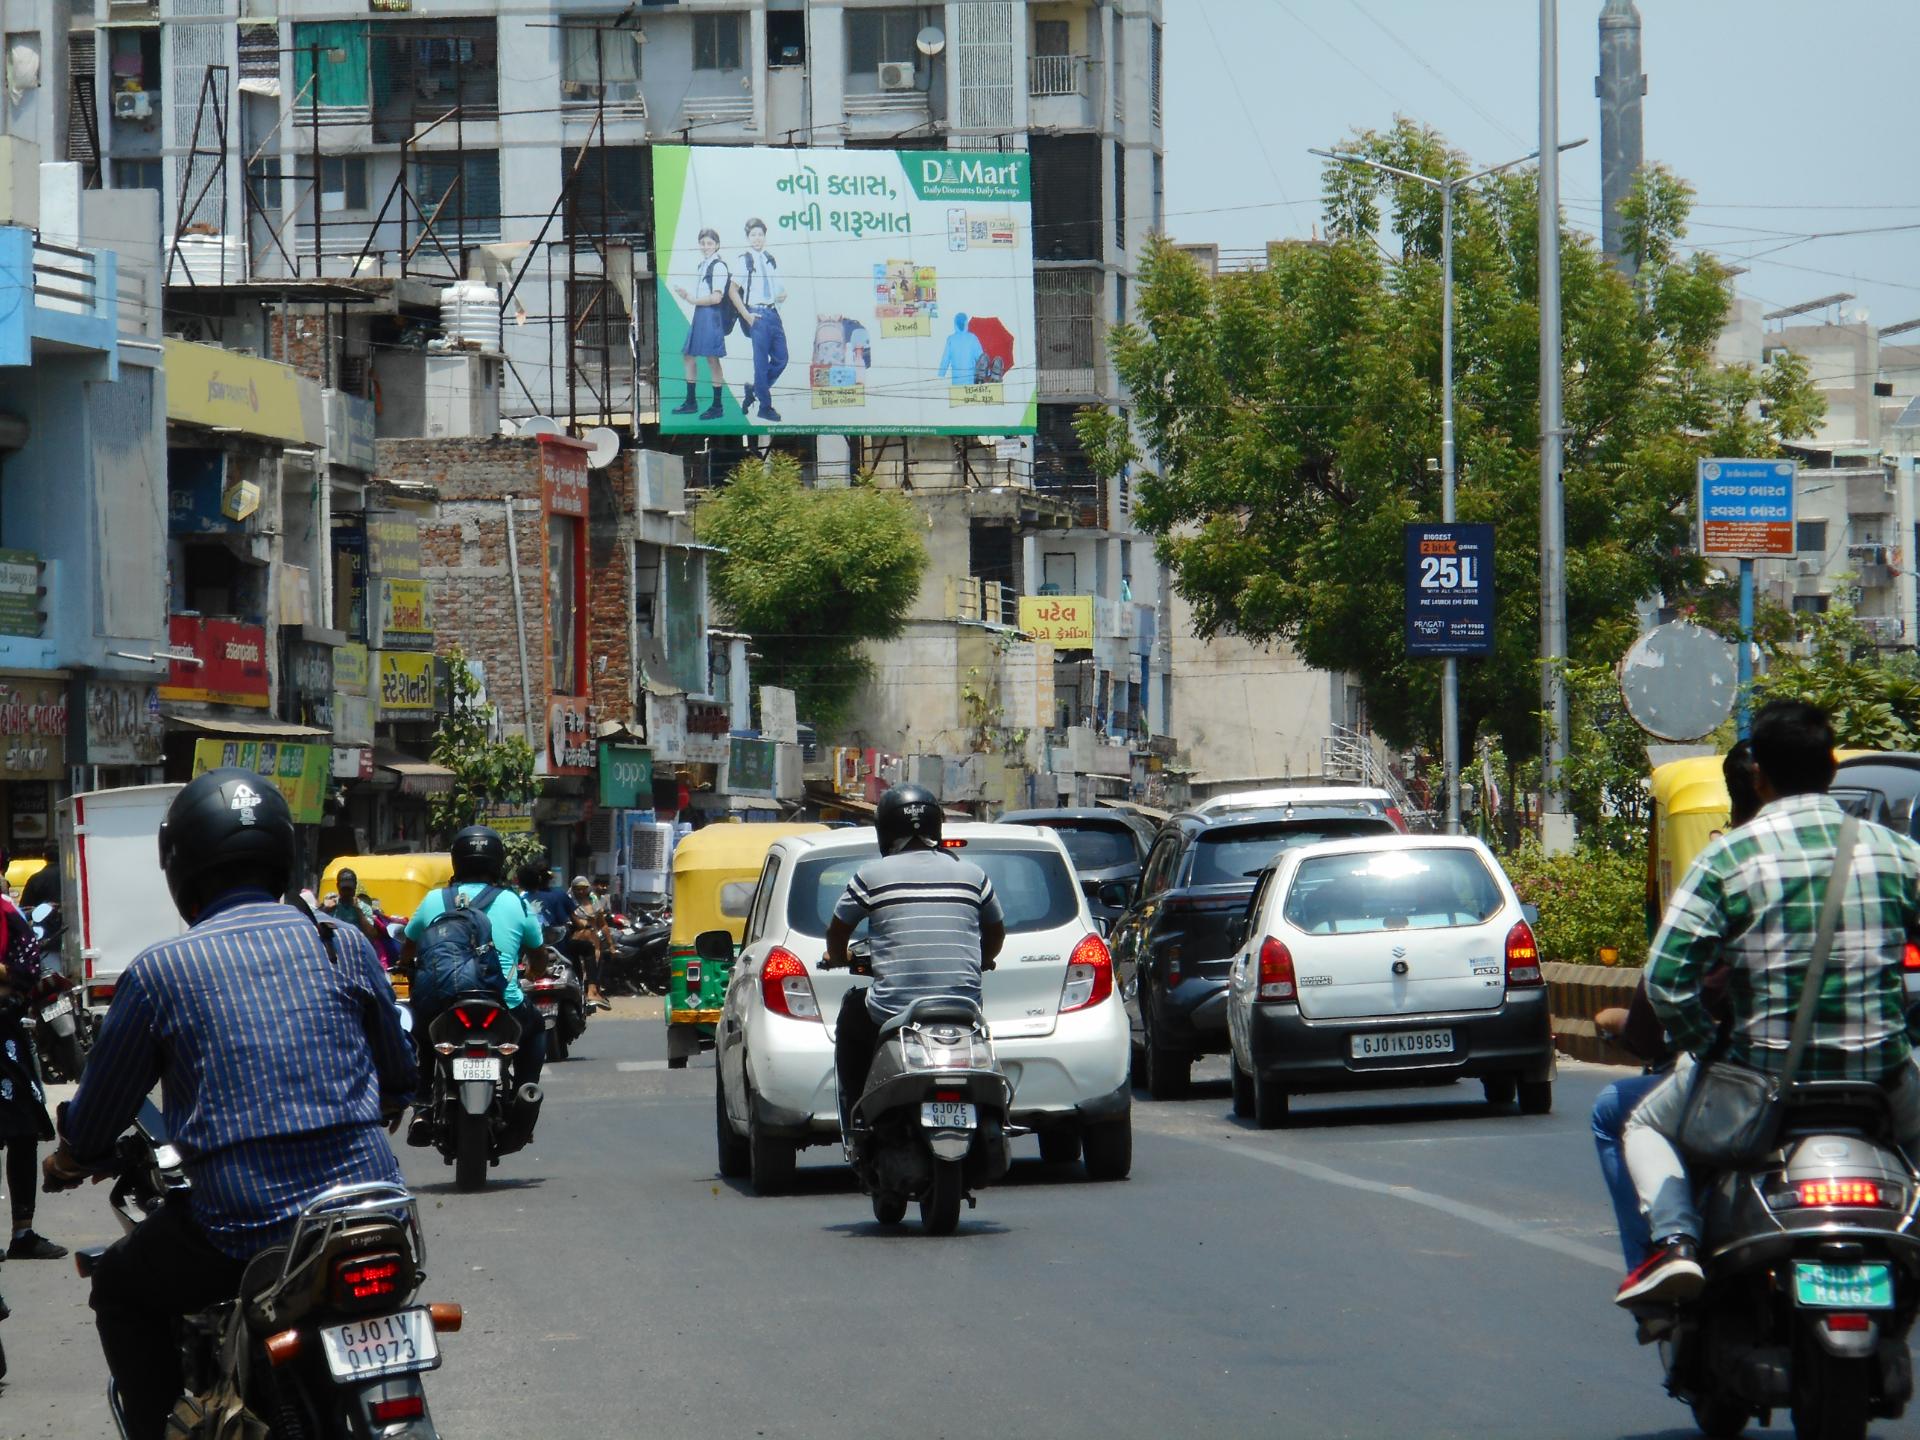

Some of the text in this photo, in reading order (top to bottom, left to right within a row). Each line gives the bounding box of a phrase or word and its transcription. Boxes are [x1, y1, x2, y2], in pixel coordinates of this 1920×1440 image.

[776, 165, 897, 200] નવો ક્લાસ,
[923, 185, 1020, 198] Daily Discounts Daily Savings
[778, 202, 912, 237] નવી શરૂઆત
[1749, 485, 1786, 497] ભારત
[1750, 506, 1787, 517] ભારત
[1423, 533, 1452, 541] BIGGEST
[1423, 543, 1430, 552] 2
[1420, 556, 1478, 588] 25L
[1037, 601, 1076, 621] પટેલ
[1414, 620, 1445, 628] PRAGATI
[1420, 627, 1439, 635] TWO
[382, 657, 432, 704] સ્ટેશનરી
[1475, 967, 1499, 975] ALTO
[1363, 1033, 1451, 1054] GJ01KD9859
[932, 1103, 966, 1115] GJ07E
[341, 1314, 407, 1347] GJ01V
